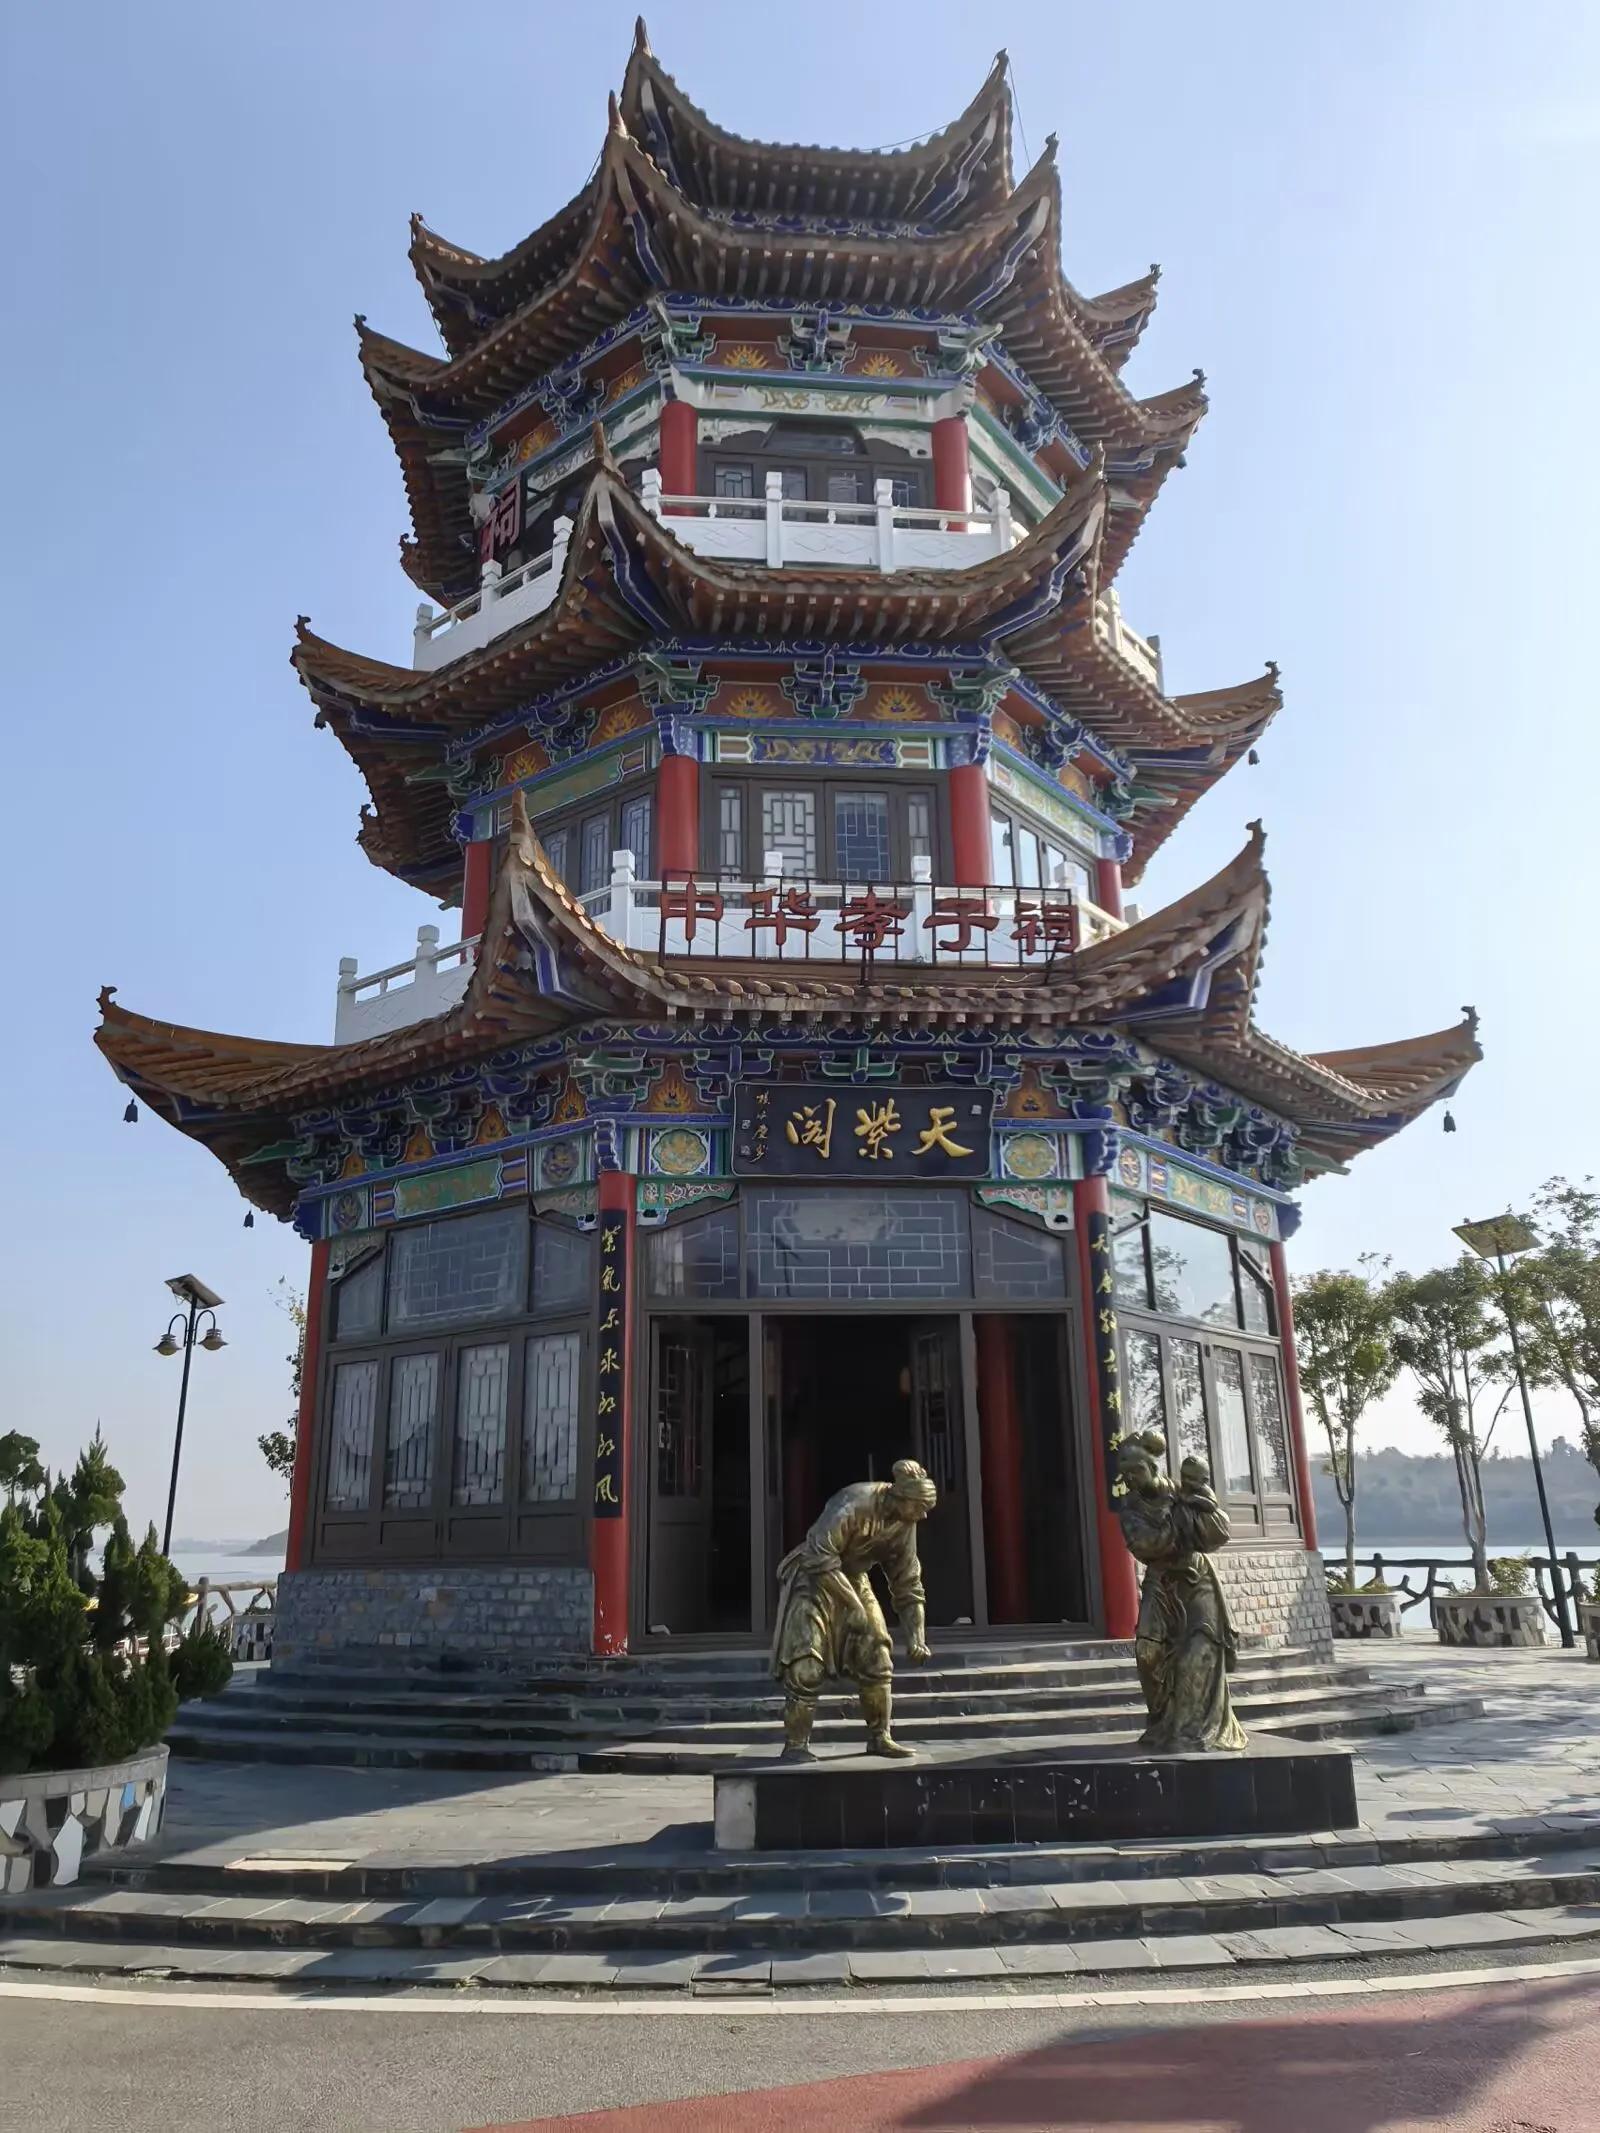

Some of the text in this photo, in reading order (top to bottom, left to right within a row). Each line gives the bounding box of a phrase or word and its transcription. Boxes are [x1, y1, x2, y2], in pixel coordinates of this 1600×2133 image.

[659, 879, 1080, 956] 中华孝子祠
